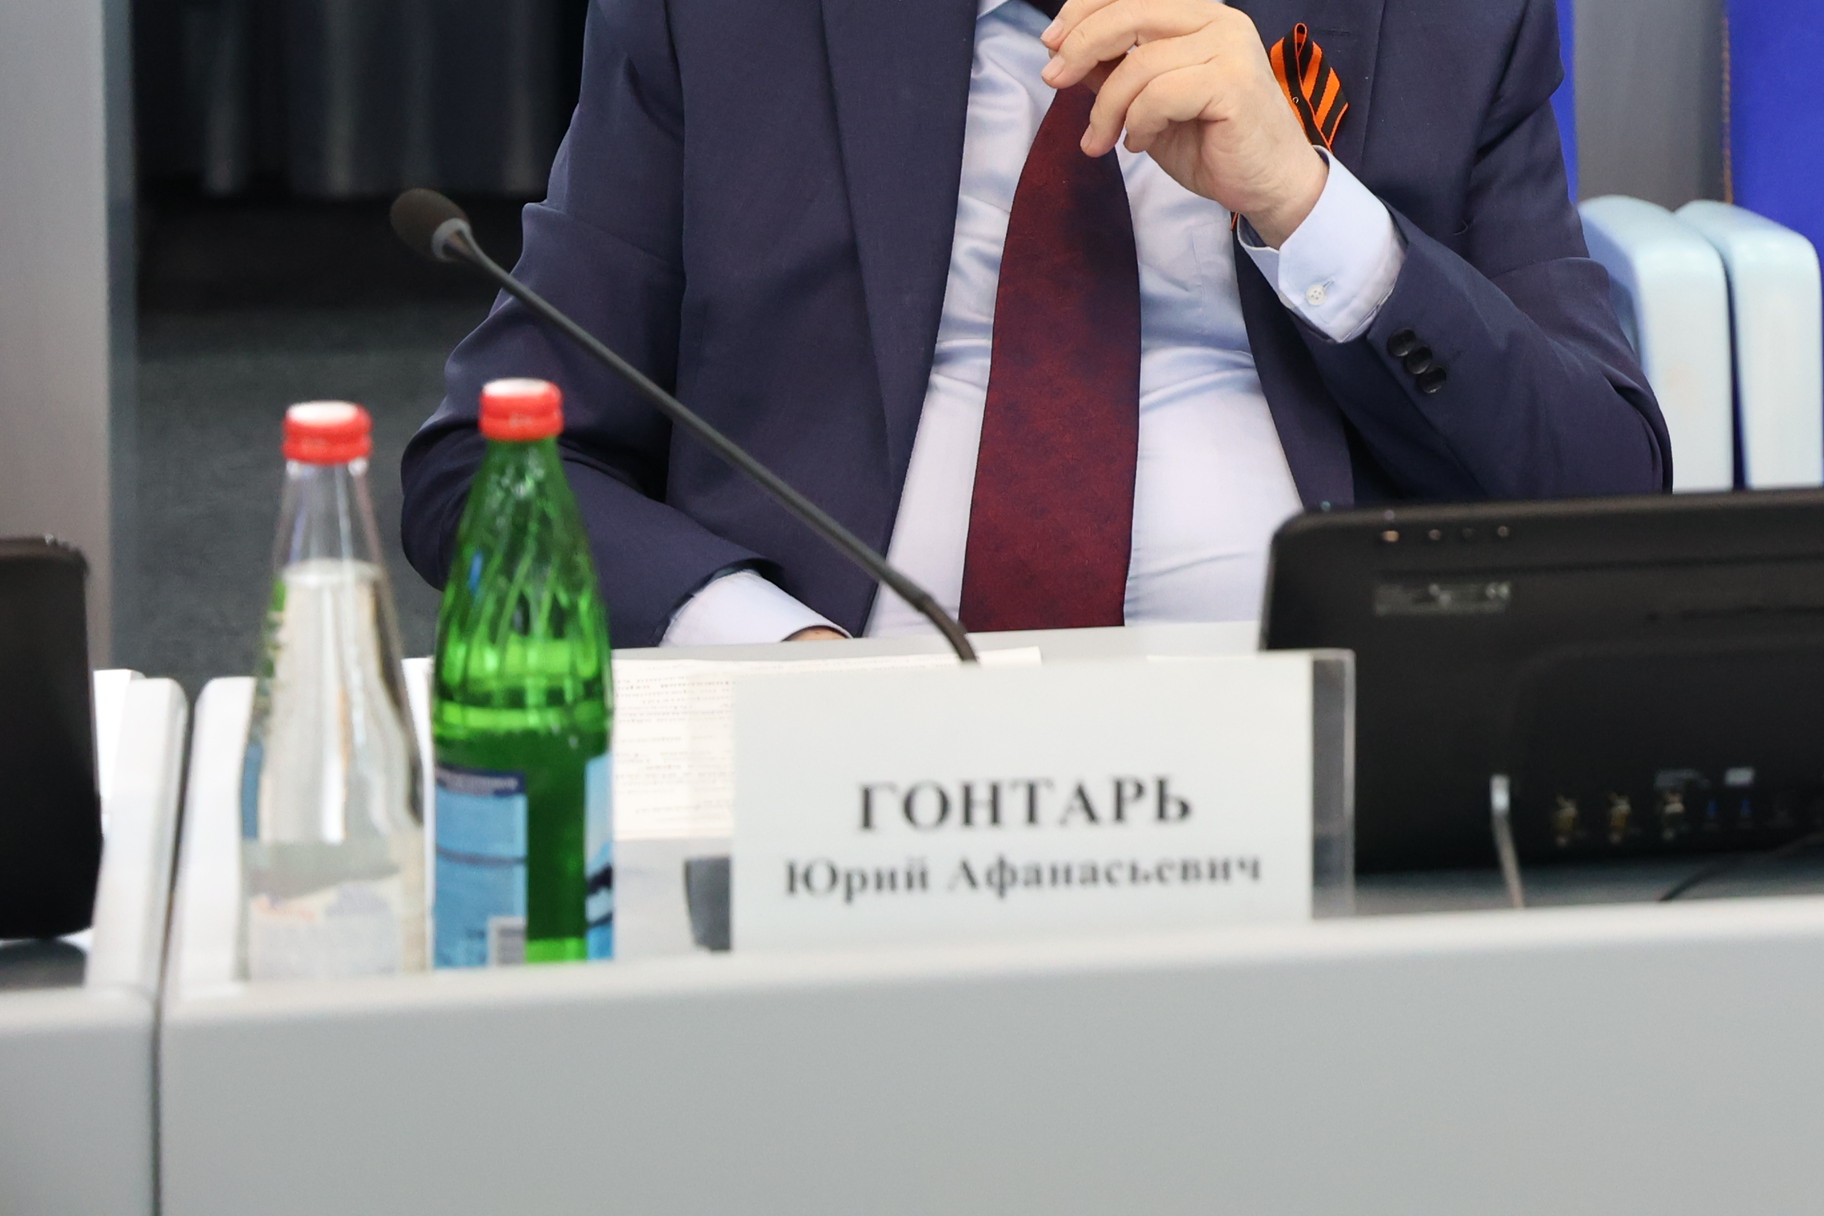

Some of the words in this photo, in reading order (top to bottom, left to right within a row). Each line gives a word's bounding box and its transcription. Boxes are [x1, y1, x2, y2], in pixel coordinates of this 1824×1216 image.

[856, 774, 1194, 833] ГОНТАРЬ
[784, 858, 930, 905] Юрий
[946, 852, 1262, 900] Афанасьевич
